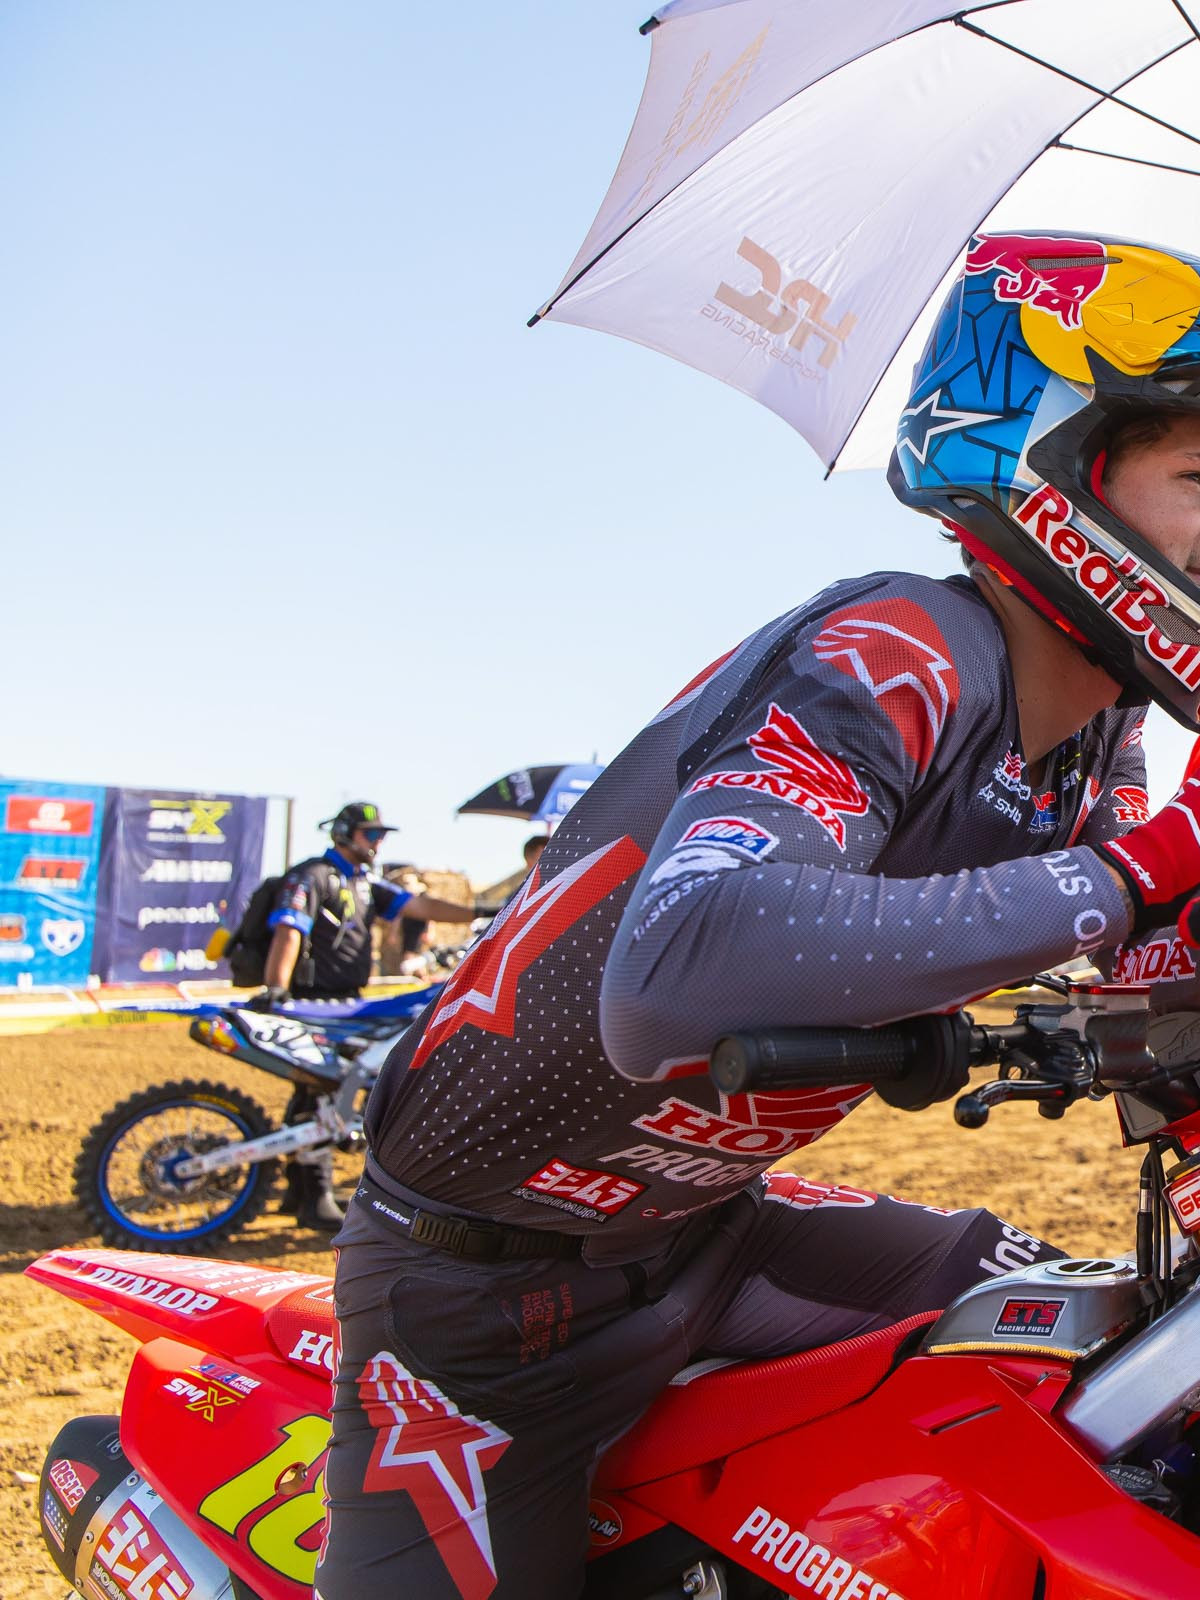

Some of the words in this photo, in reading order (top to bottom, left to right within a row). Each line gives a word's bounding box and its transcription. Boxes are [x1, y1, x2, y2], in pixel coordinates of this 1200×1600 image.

[1012, 482, 1141, 605] Red
[682, 771, 847, 853] HONDA
[691, 822, 760, 848] 100%
[88, 1266, 220, 1316] DUNLOP
[997, 1325, 1026, 1333] RACING
[1027, 1325, 1051, 1334] FUELS
[1001, 1302, 1061, 1324] ETS
[233, 1375, 262, 1389] PRO
[50, 1459, 87, 1508] RS12
